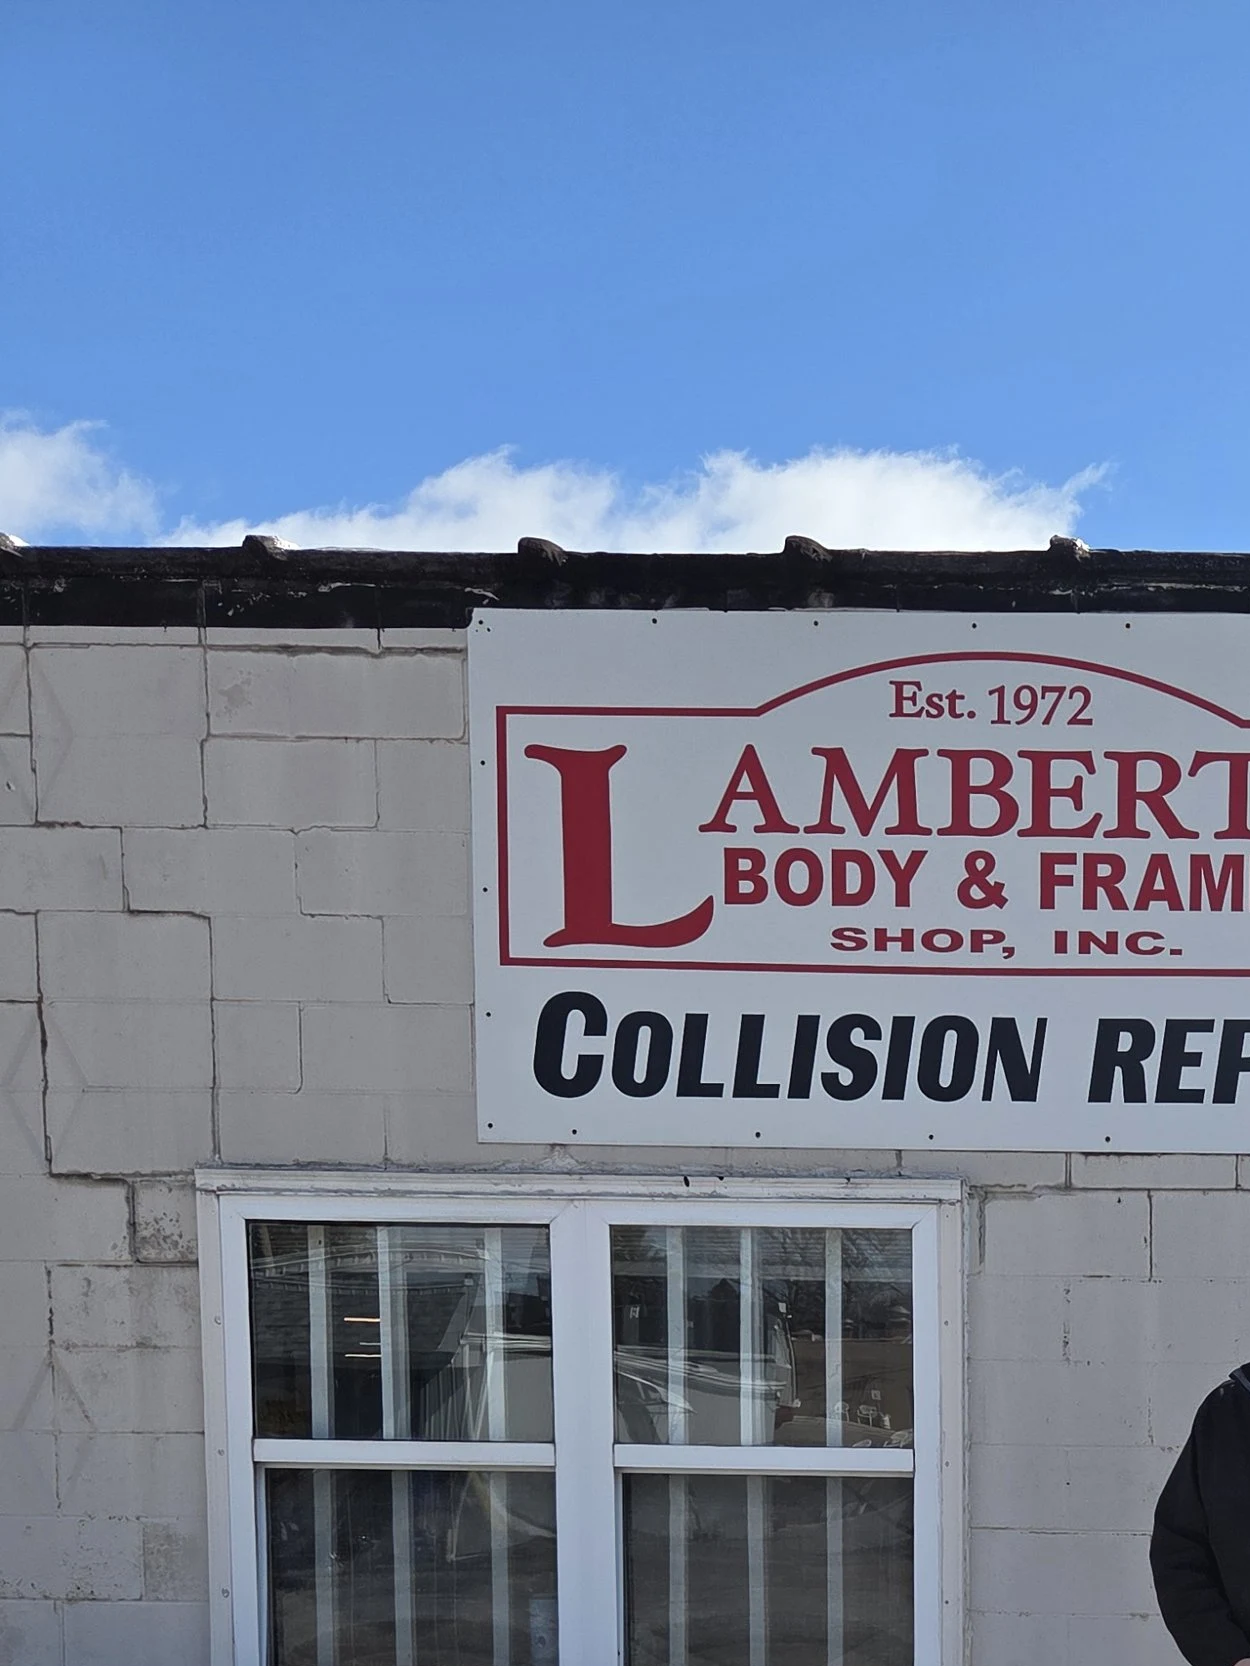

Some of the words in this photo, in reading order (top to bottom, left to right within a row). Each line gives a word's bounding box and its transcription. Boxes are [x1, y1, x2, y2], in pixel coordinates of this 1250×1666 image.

[888, 680, 976, 721] Est.
[988, 685, 1094, 727] 1972
[723, 847, 927, 907] BODY
[957, 850, 1009, 910] &
[829, 926, 1017, 960] SHOP,
[1052, 930, 1184, 957] INC.
[533, 990, 1047, 1103] COLLISION
